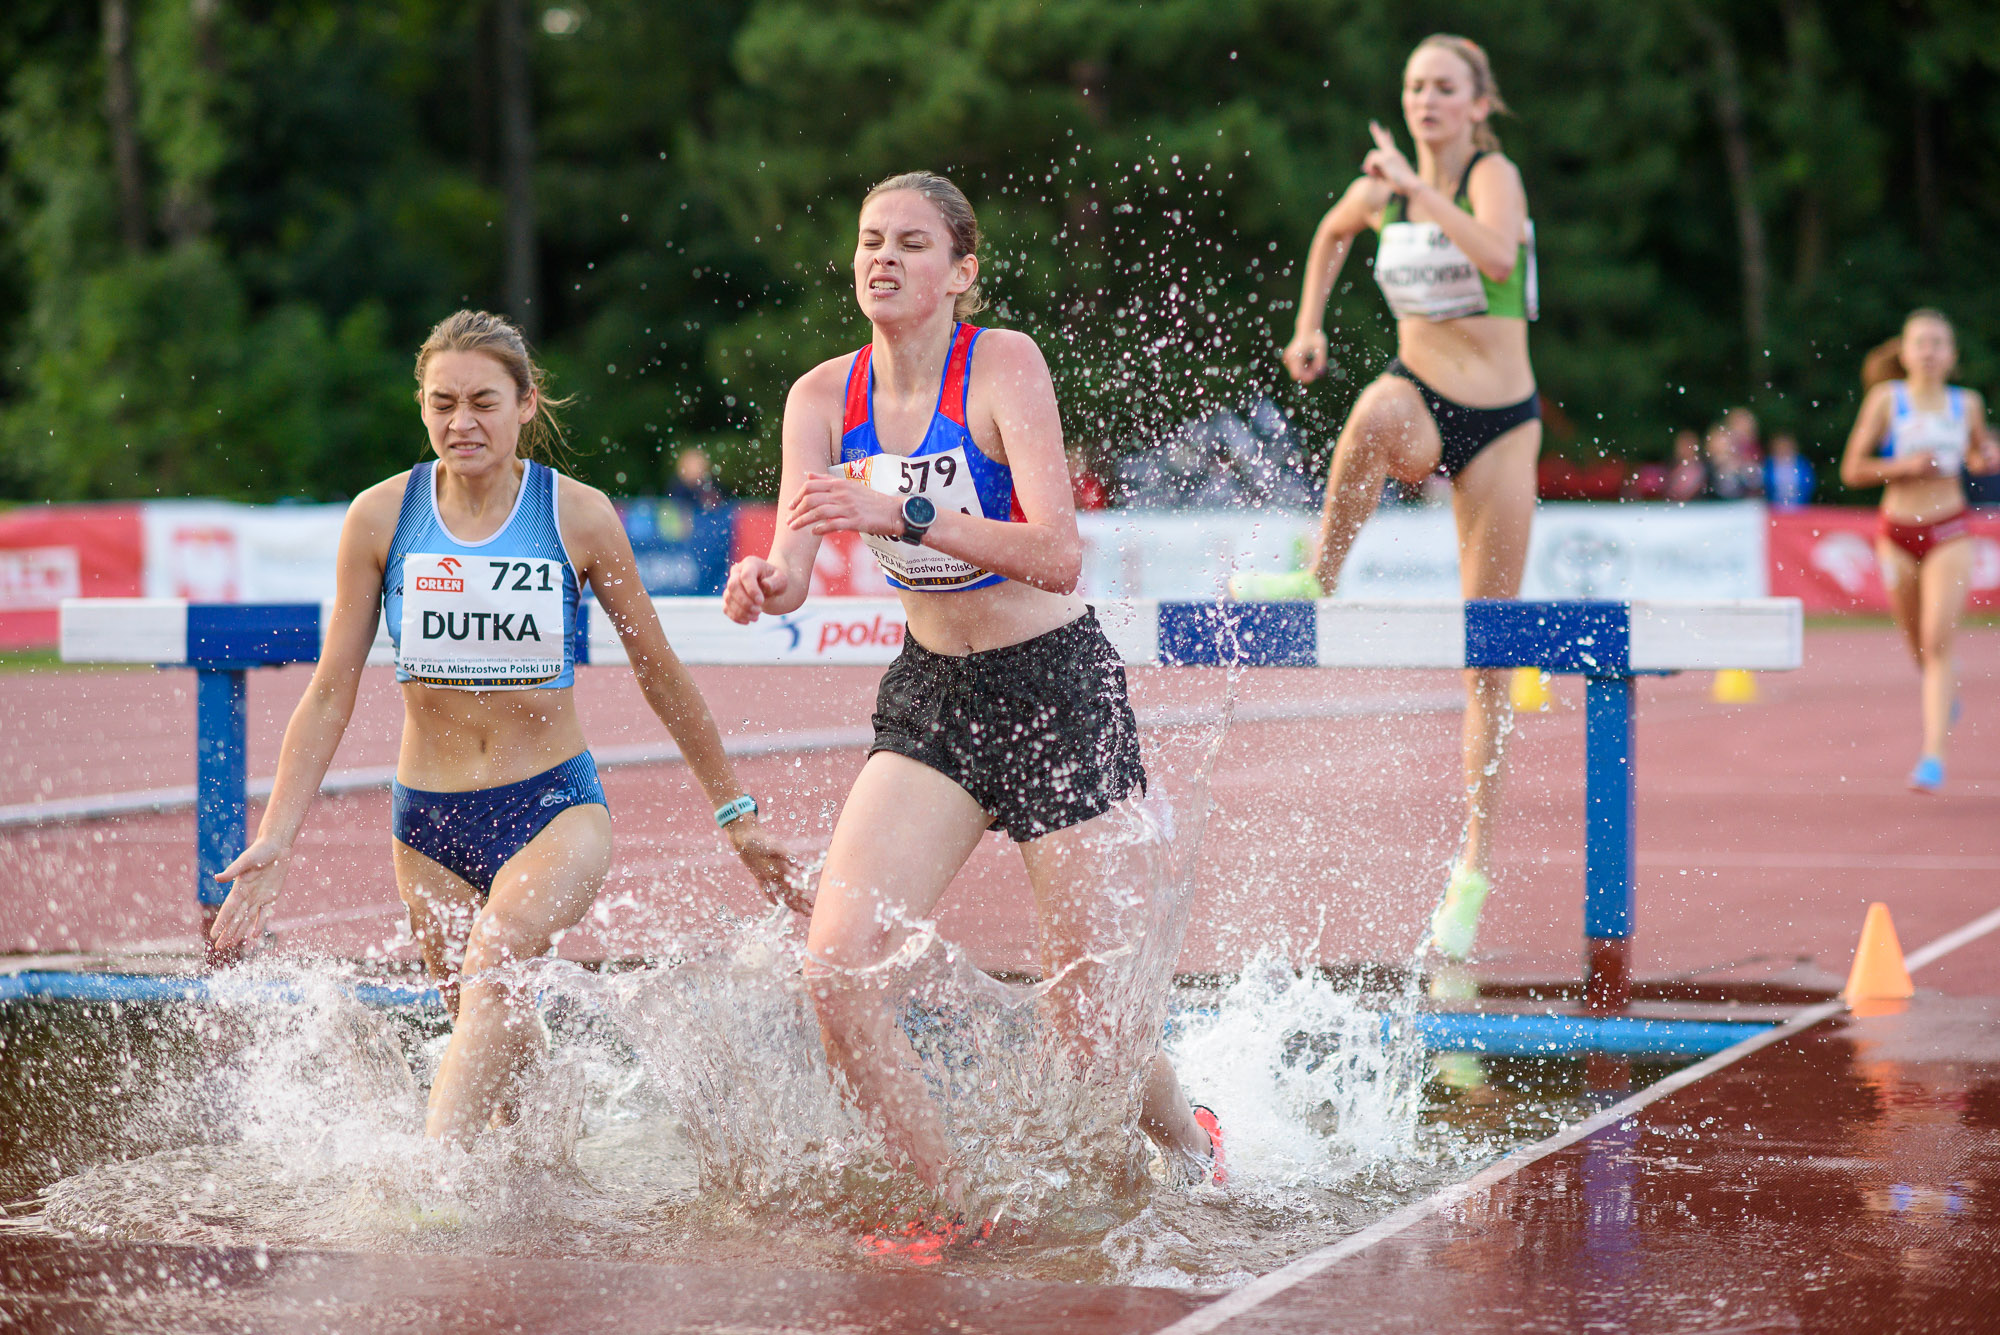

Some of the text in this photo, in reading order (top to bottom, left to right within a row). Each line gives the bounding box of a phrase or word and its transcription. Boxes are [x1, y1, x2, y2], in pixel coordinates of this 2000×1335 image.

[898, 456, 957, 494] 579
[489, 561, 554, 592] 721
[422, 610, 542, 642] DUTKA
[816, 613, 905, 655] pola
[403, 663, 561, 674] 54. PZLA Mistrzostwa Polski U18
